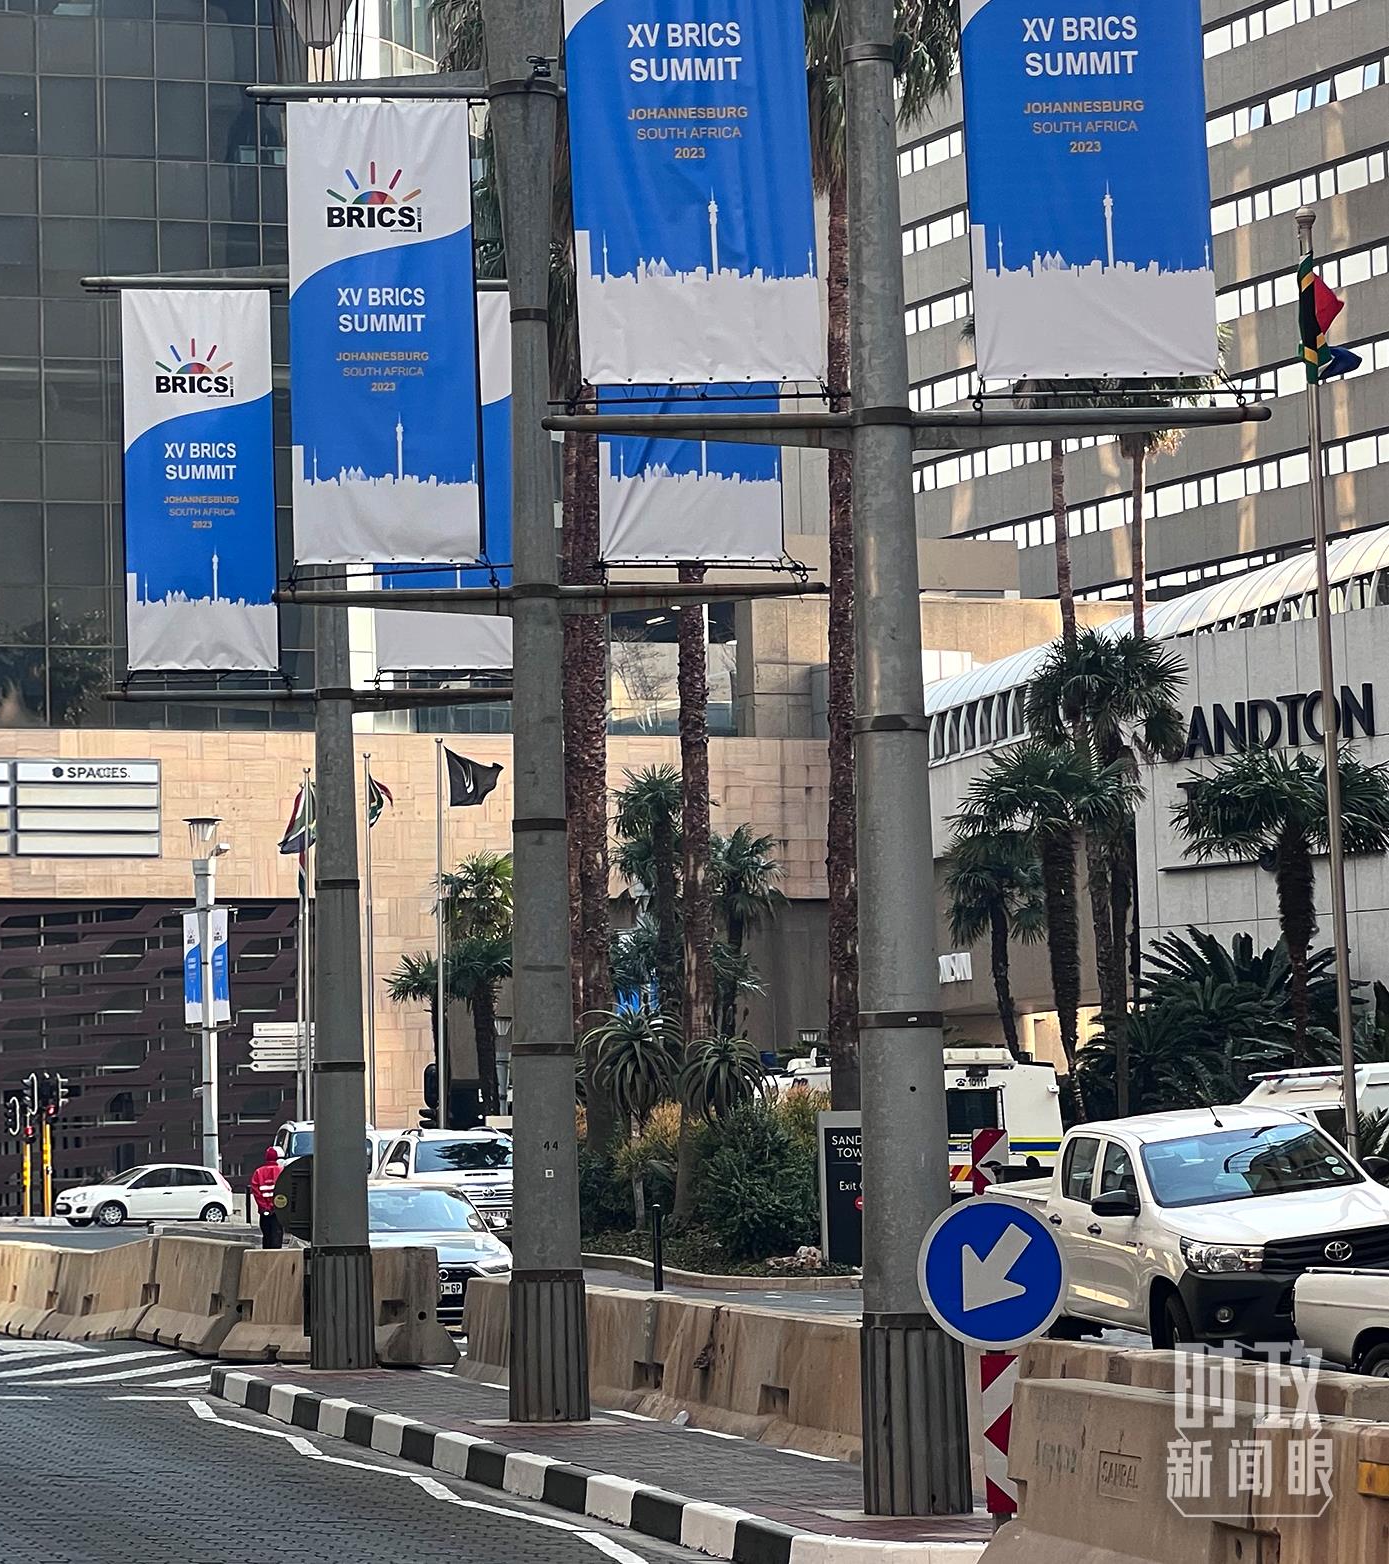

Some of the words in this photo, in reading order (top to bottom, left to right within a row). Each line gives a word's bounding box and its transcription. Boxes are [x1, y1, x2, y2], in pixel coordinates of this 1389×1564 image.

[627, 23, 660, 48] XV
[667, 22, 741, 47] BRICS
[1022, 18, 1054, 42] XV
[1062, 16, 1137, 41] BRICS
[630, 57, 742, 82] SUMMIT
[1025, 50, 1139, 76] SUMMIT
[628, 106, 748, 121] JOHANNESBURG
[1023, 100, 1144, 115] JOHANNESBURG
[637, 128, 686, 140] SOUTH
[689, 127, 743, 139] AFRICA
[1032, 121, 1082, 134] SOUTH
[1085, 120, 1139, 133] AFRICA
[674, 147, 706, 159] 2023
[1069, 141, 1102, 153] 2023
[327, 206, 416, 228] BRICS
[337, 287, 363, 306] XV
[368, 287, 426, 306] BRICS
[338, 313, 426, 333] SUMMIT
[336, 351, 429, 361] JOHANNESBURG
[342, 366, 382, 377] SOUTH
[383, 366, 425, 377] AFRICA
[155, 375, 229, 394] BRICS
[371, 382, 396, 392] 2023
[164, 442, 185, 459] XV
[189, 442, 237, 459] BRICS
[165, 464, 237, 480] SUMMIT
[164, 495, 240, 504] JOHANNESBURG
[831, 1135, 862, 1146] SAND
[836, 1147, 862, 1158] TOW
[839, 1180, 857, 1191] Exit
